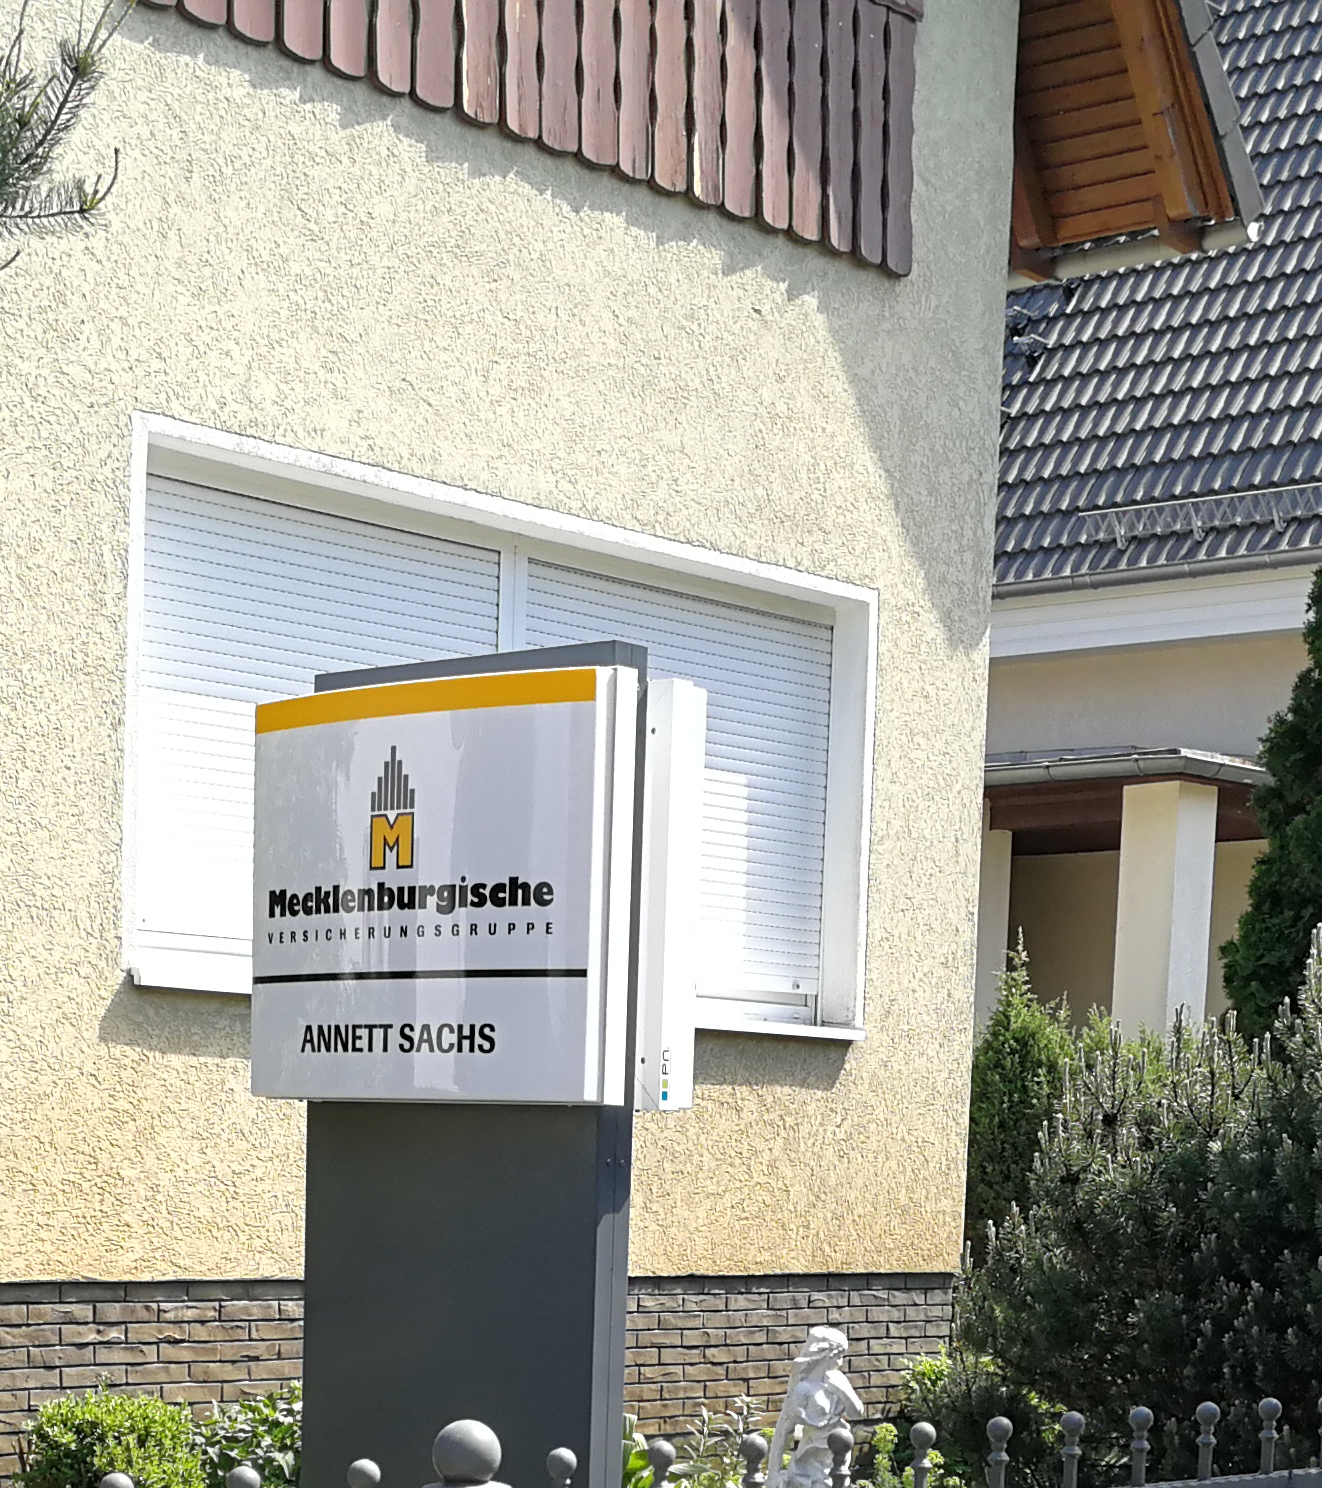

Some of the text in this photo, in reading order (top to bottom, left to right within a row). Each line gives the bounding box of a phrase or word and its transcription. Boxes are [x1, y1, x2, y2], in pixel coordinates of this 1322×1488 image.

[268, 875, 554, 919] Mecklenburgische
[268, 922, 554, 944] VERSICHERUNGSGRUPPE
[301, 1023, 496, 1054] ANNETT SACHS
